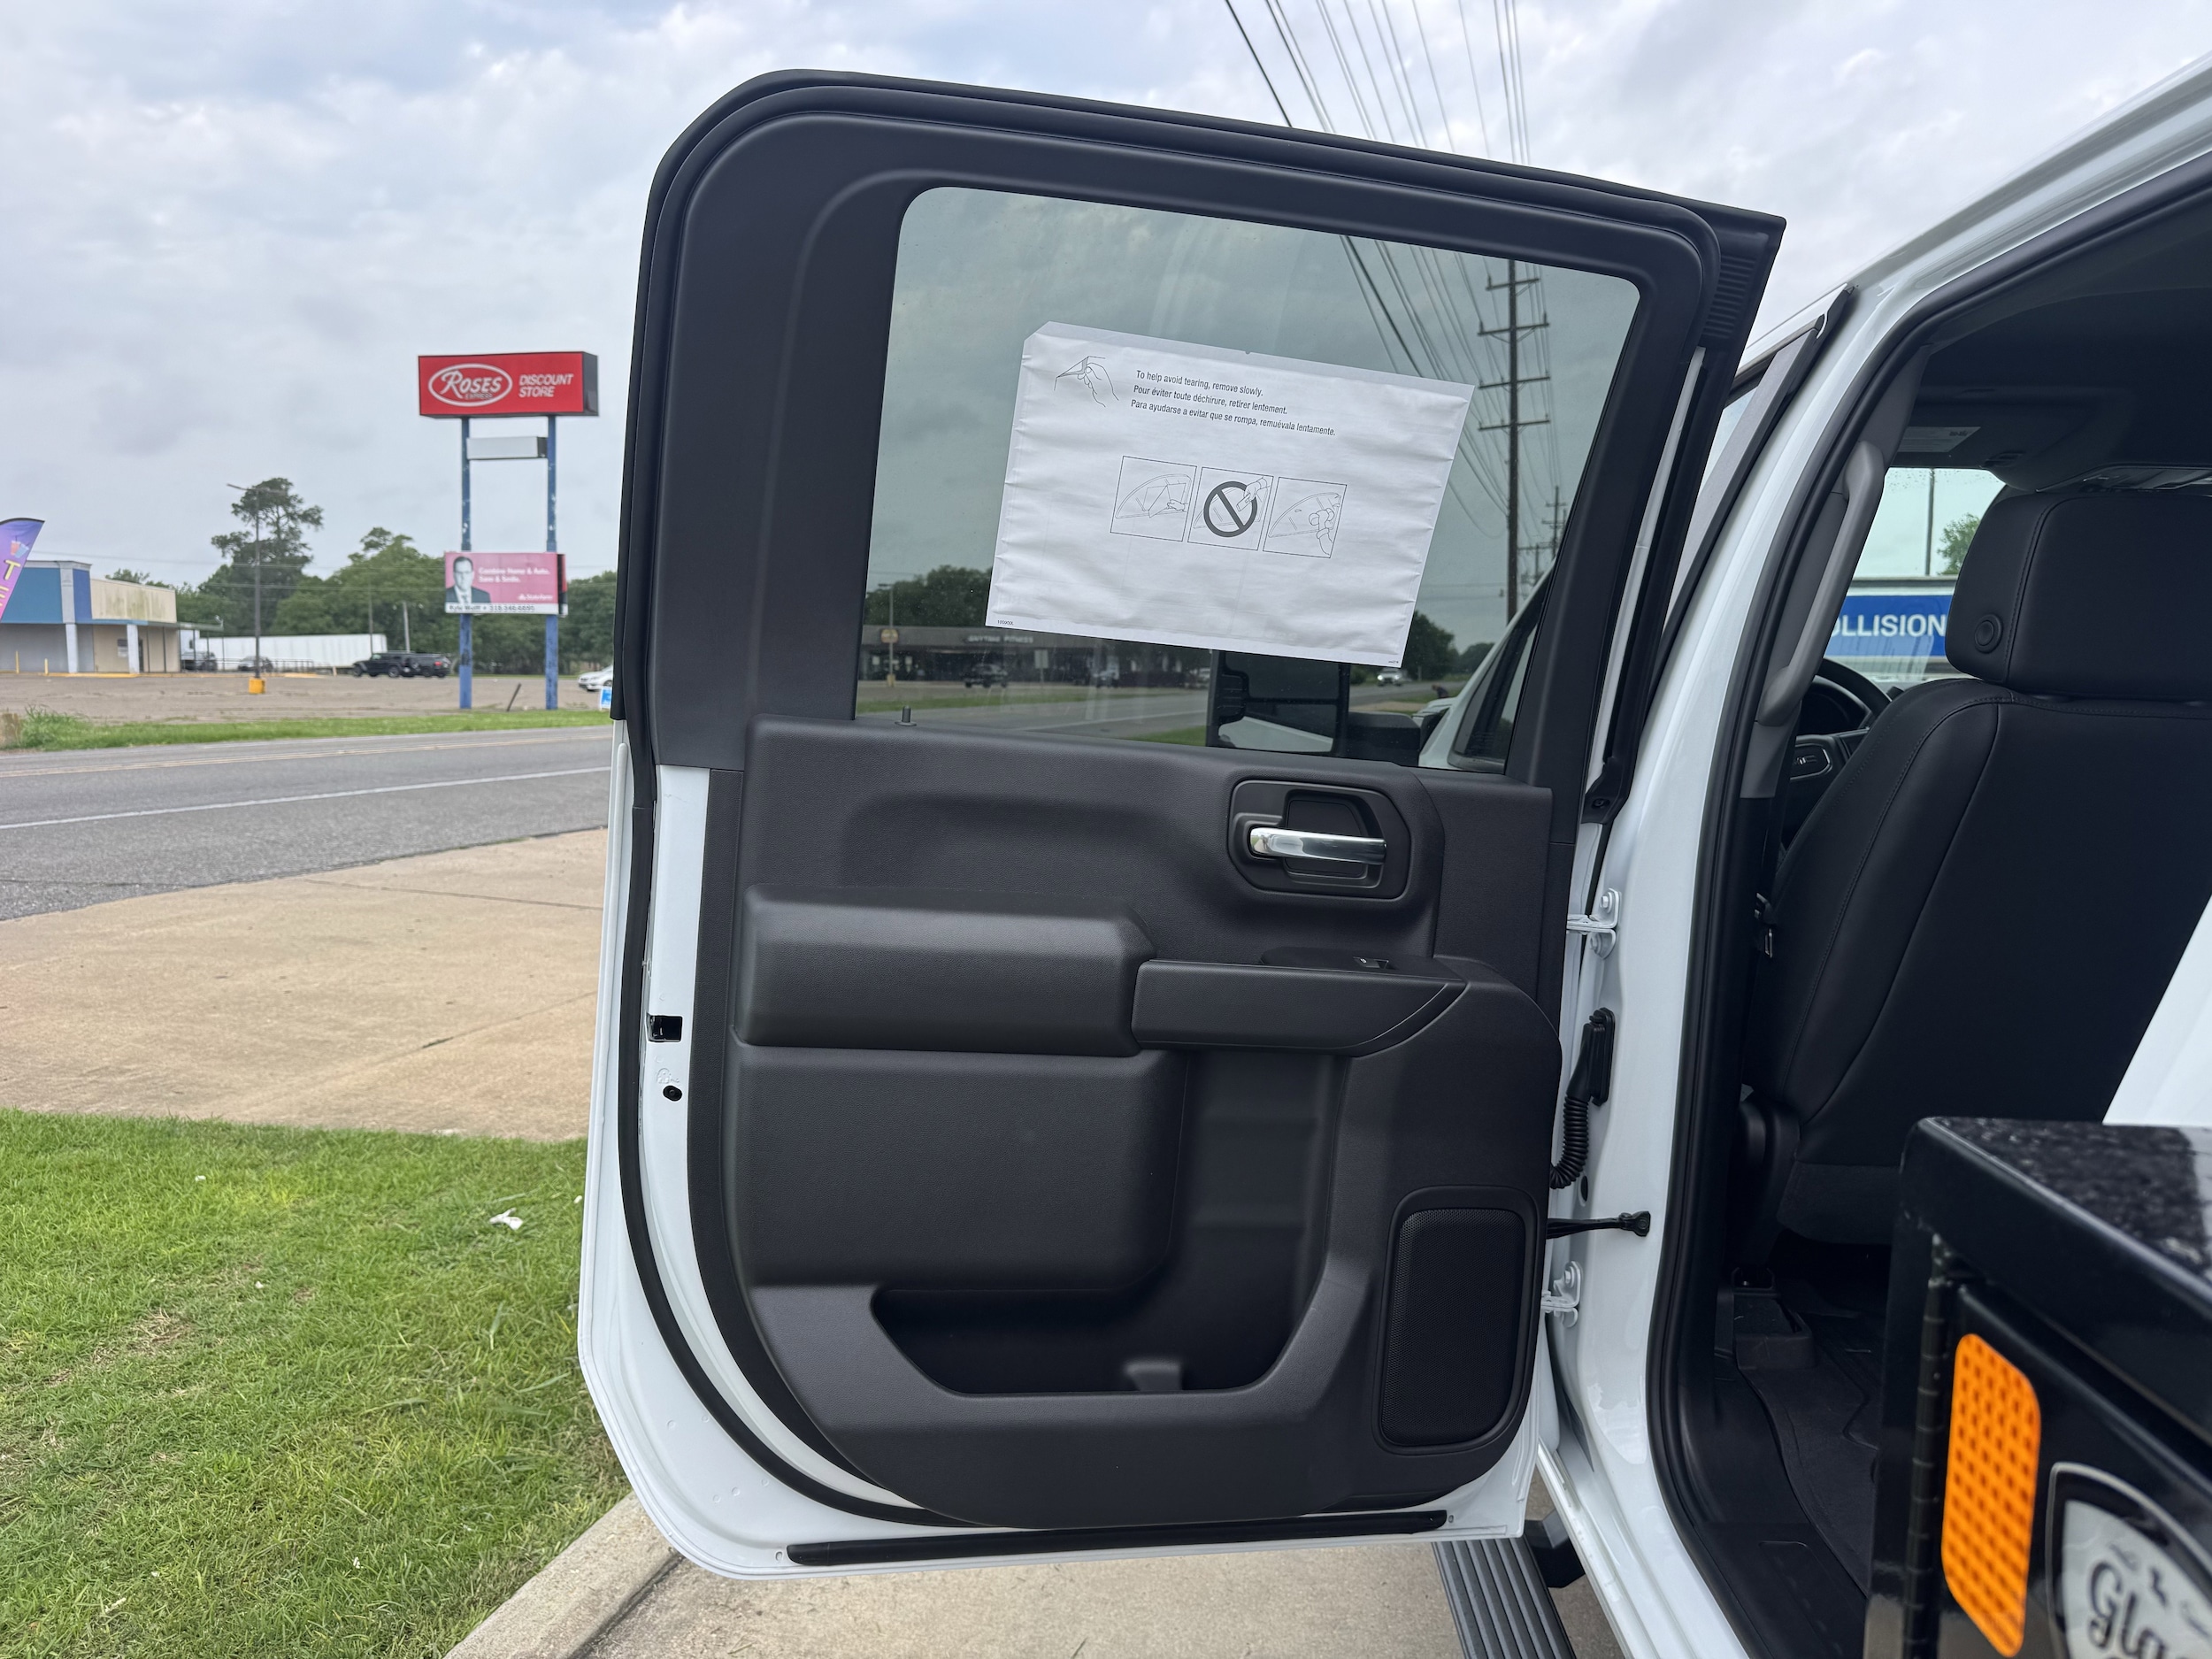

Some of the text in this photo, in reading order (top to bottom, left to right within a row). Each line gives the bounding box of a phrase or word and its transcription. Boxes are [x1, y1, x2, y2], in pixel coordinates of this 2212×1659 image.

[518, 373, 573, 386] DISCOUNT
[518, 386, 555, 397] STORE
[1136, 370, 1145, 380] To
[1147, 372, 1162, 382] help
[1164, 374, 1183, 385] avoid
[1184, 377, 1210, 390] tearing,
[1212, 382, 1238, 393] remove
[1240, 386, 1263, 397] slowly.
[1133, 385, 1287, 415] Pour éviter toute déchirure, retirer lentement.
[1131, 399, 1148, 409] Para
[1148, 403, 1181, 414] ayudarse
[1189, 409, 1208, 419] evitar
[1210, 411, 1223, 421] que
[1224, 413, 1233, 422] se
[1233, 415, 1258, 426] rompa,
[1260, 418, 1295, 431] remuévala
[1296, 423, 1336, 436] lentamente.
